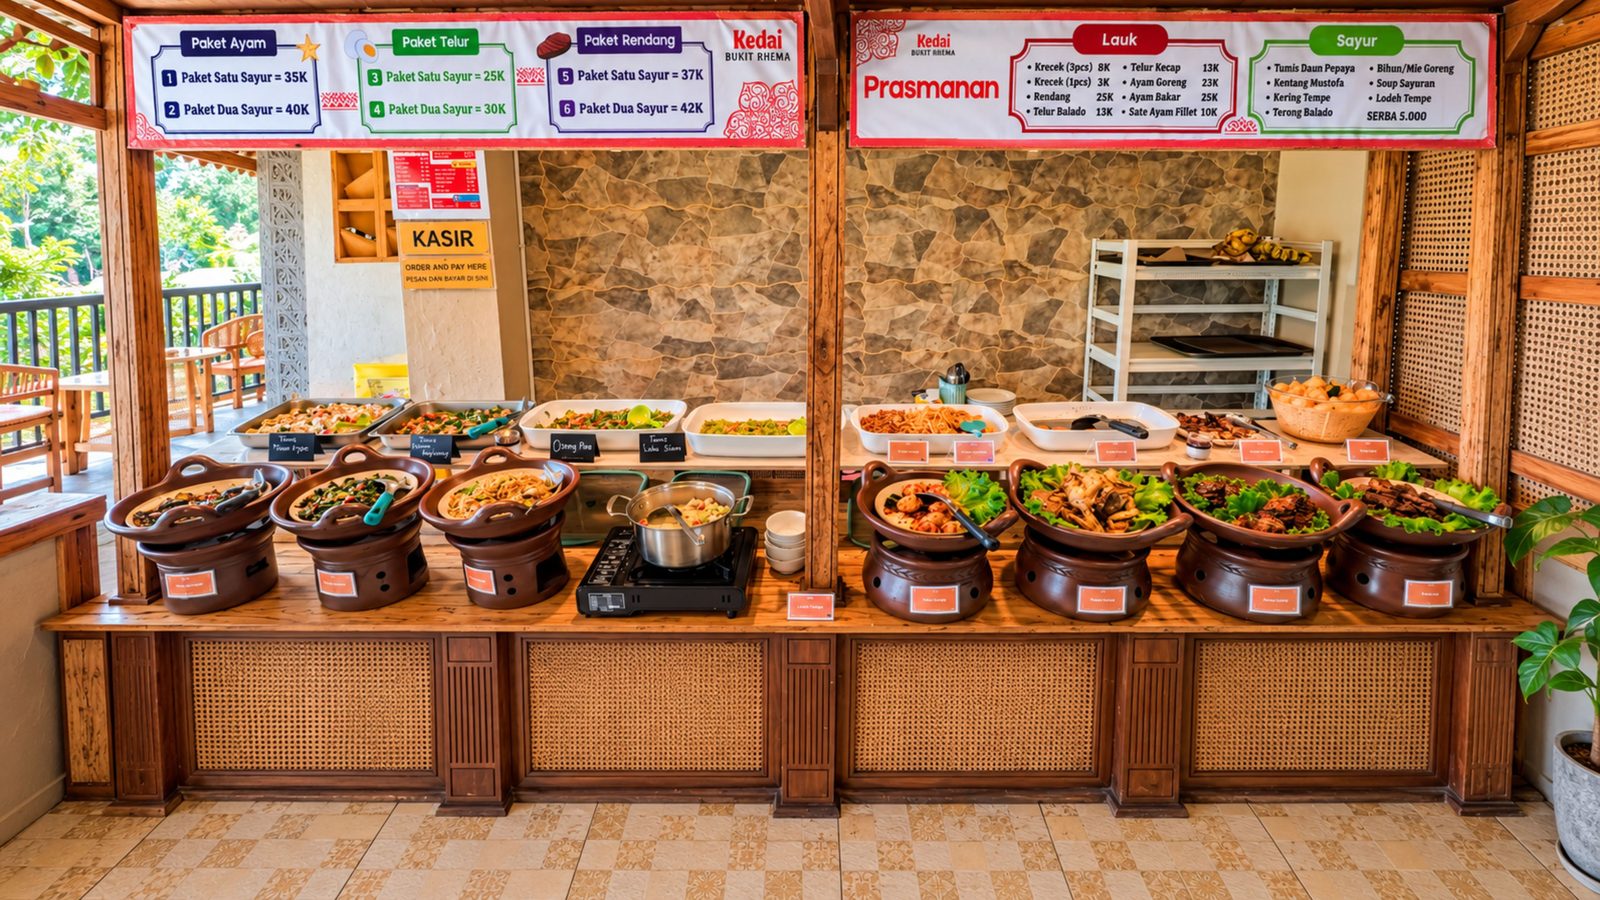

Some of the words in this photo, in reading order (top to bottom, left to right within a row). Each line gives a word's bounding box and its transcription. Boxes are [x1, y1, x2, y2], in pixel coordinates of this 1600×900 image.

[192, 37, 226, 49] Paket
[230, 37, 266, 52] Ayam
[402, 36, 436, 48] Paket
[440, 36, 469, 47] Telur
[584, 34, 618, 46] Paket
[622, 34, 675, 49] Rendang
[733, 29, 782, 49] Kedai
[917, 33, 951, 48] Kedai
[1102, 33, 1137, 46] Lauk
[1337, 34, 1378, 50] Sayur
[725, 52, 753, 61] BUKIT
[757, 52, 791, 61] RHEMA
[1035, 62, 1064, 72] Krecek
[1066, 62, 1093, 73] (3pcs)
[1098, 63, 1111, 72] 8K
[1130, 63, 1154, 72] Telur
[1155, 63, 1181, 74] Kecap
[1203, 64, 1219, 72] 13K
[1274, 64, 1299, 72] Tumis
[1301, 64, 1323, 72] Daun
[1324, 64, 1355, 74] Pepaya
[1377, 64, 1422, 73] Bihun/Mie
[1424, 64, 1455, 75] Goreng
[166, 73, 172, 83] 1
[182, 71, 212, 83] Paket
[214, 72, 238, 83] Satu
[241, 71, 272, 85] Sayur
[284, 71, 308, 83] 35K
[372, 73, 378, 83] 3
[386, 71, 416, 82] Paket
[418, 71, 440, 82] Satu
[443, 71, 472, 84] Sayur
[483, 70, 505, 81] 25K
[562, 71, 569, 82] 5
[578, 69, 608, 81] Paket
[611, 69, 636, 80] Satu
[638, 69, 670, 83] Sayur
[681, 69, 703, 80] 37K
[864, 75, 999, 99] Prasmanan
[1034, 77, 1064, 86] Krecek
[1066, 77, 1092, 88] (1pcs)
[1097, 78, 1110, 86] 3K
[1130, 78, 1154, 88] Ayam
[1156, 78, 1187, 89] Goreng
[1202, 78, 1219, 87] 23K
[1274, 78, 1309, 89] Kentang
[1310, 78, 1344, 87] Mustofa
[1377, 78, 1398, 90] Soup
[1399, 79, 1435, 90] Sayuran
[1034, 92, 1071, 103] Rendang
[1096, 93, 1114, 101] 25K
[1129, 93, 1154, 103] Ayam
[1155, 92, 1181, 101] Bakar
[1201, 93, 1218, 102] 25K
[1273, 93, 1301, 104] Kering
[1303, 93, 1331, 104] Tempe
[1376, 93, 1402, 103] Lodeh
[1404, 94, 1432, 105] Tempe
[169, 105, 175, 115] 2
[184, 104, 215, 115] Paket
[217, 104, 238, 115] Dua
[241, 104, 273, 117] Sayur
[285, 104, 309, 115] 40K
[374, 104, 381, 115] 4
[389, 103, 419, 115] Paket
[421, 104, 440, 114] Dua
[443, 103, 473, 117] Sayur
[484, 103, 506, 114] 30K
[564, 104, 571, 114] 6
[579, 102, 610, 114] Paket
[613, 103, 634, 114] Dua
[637, 102, 668, 116] Sayur
[680, 102, 703, 113] 42K
[1033, 107, 1055, 116] Telur
[1057, 107, 1086, 116] Balado
[1096, 108, 1113, 116] 13K
[1129, 107, 1148, 116] Sate
[1149, 108, 1174, 118] Ayam
[1175, 107, 1197, 116] Fillet
[1201, 108, 1217, 116] 10K
[1273, 108, 1302, 119] Terong
[1304, 107, 1333, 117] Balado
[1367, 111, 1397, 121] SERBA
[1399, 111, 1427, 121] 5.000
[413, 230, 474, 247] KASIR
